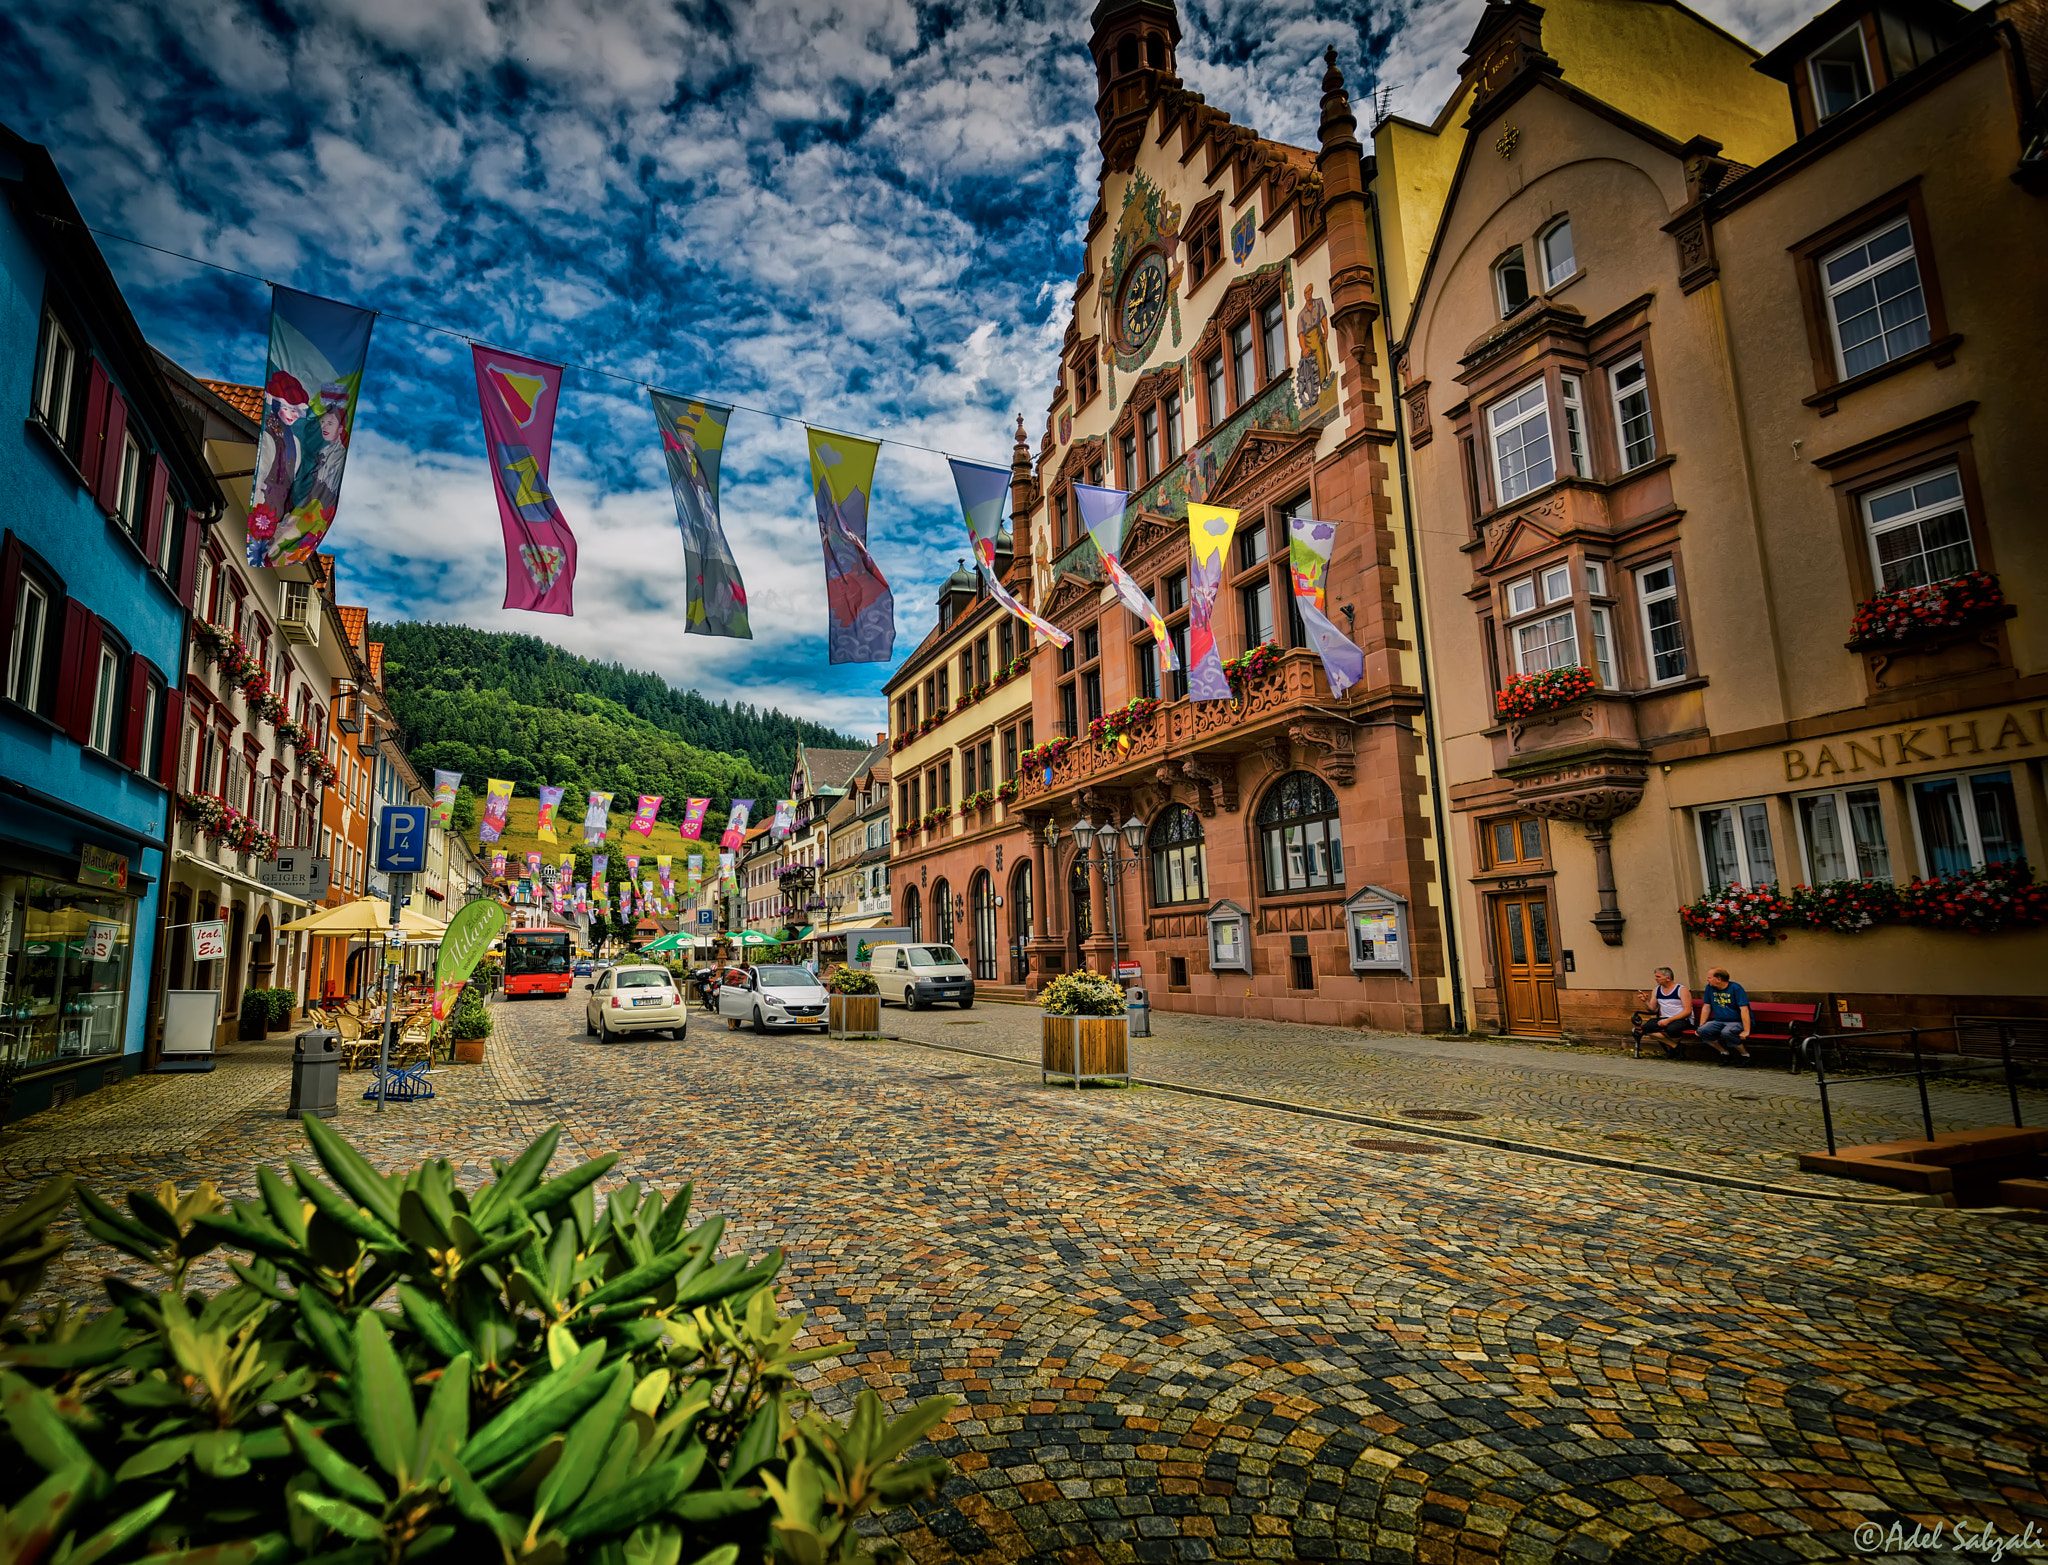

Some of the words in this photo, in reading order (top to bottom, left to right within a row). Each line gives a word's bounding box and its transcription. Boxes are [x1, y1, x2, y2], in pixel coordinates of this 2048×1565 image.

[389, 813, 415, 849] P
[400, 836, 409, 850] 4
[1498, 879, 1528, 890] 43-45
[863, 899, 875, 912] Hotel
[876, 896, 890, 910] Garni
[702, 912, 710, 922] P
[197, 928, 222, 940] Ital.
[442, 907, 494, 972] Milano
[198, 942, 222, 956] Eis
